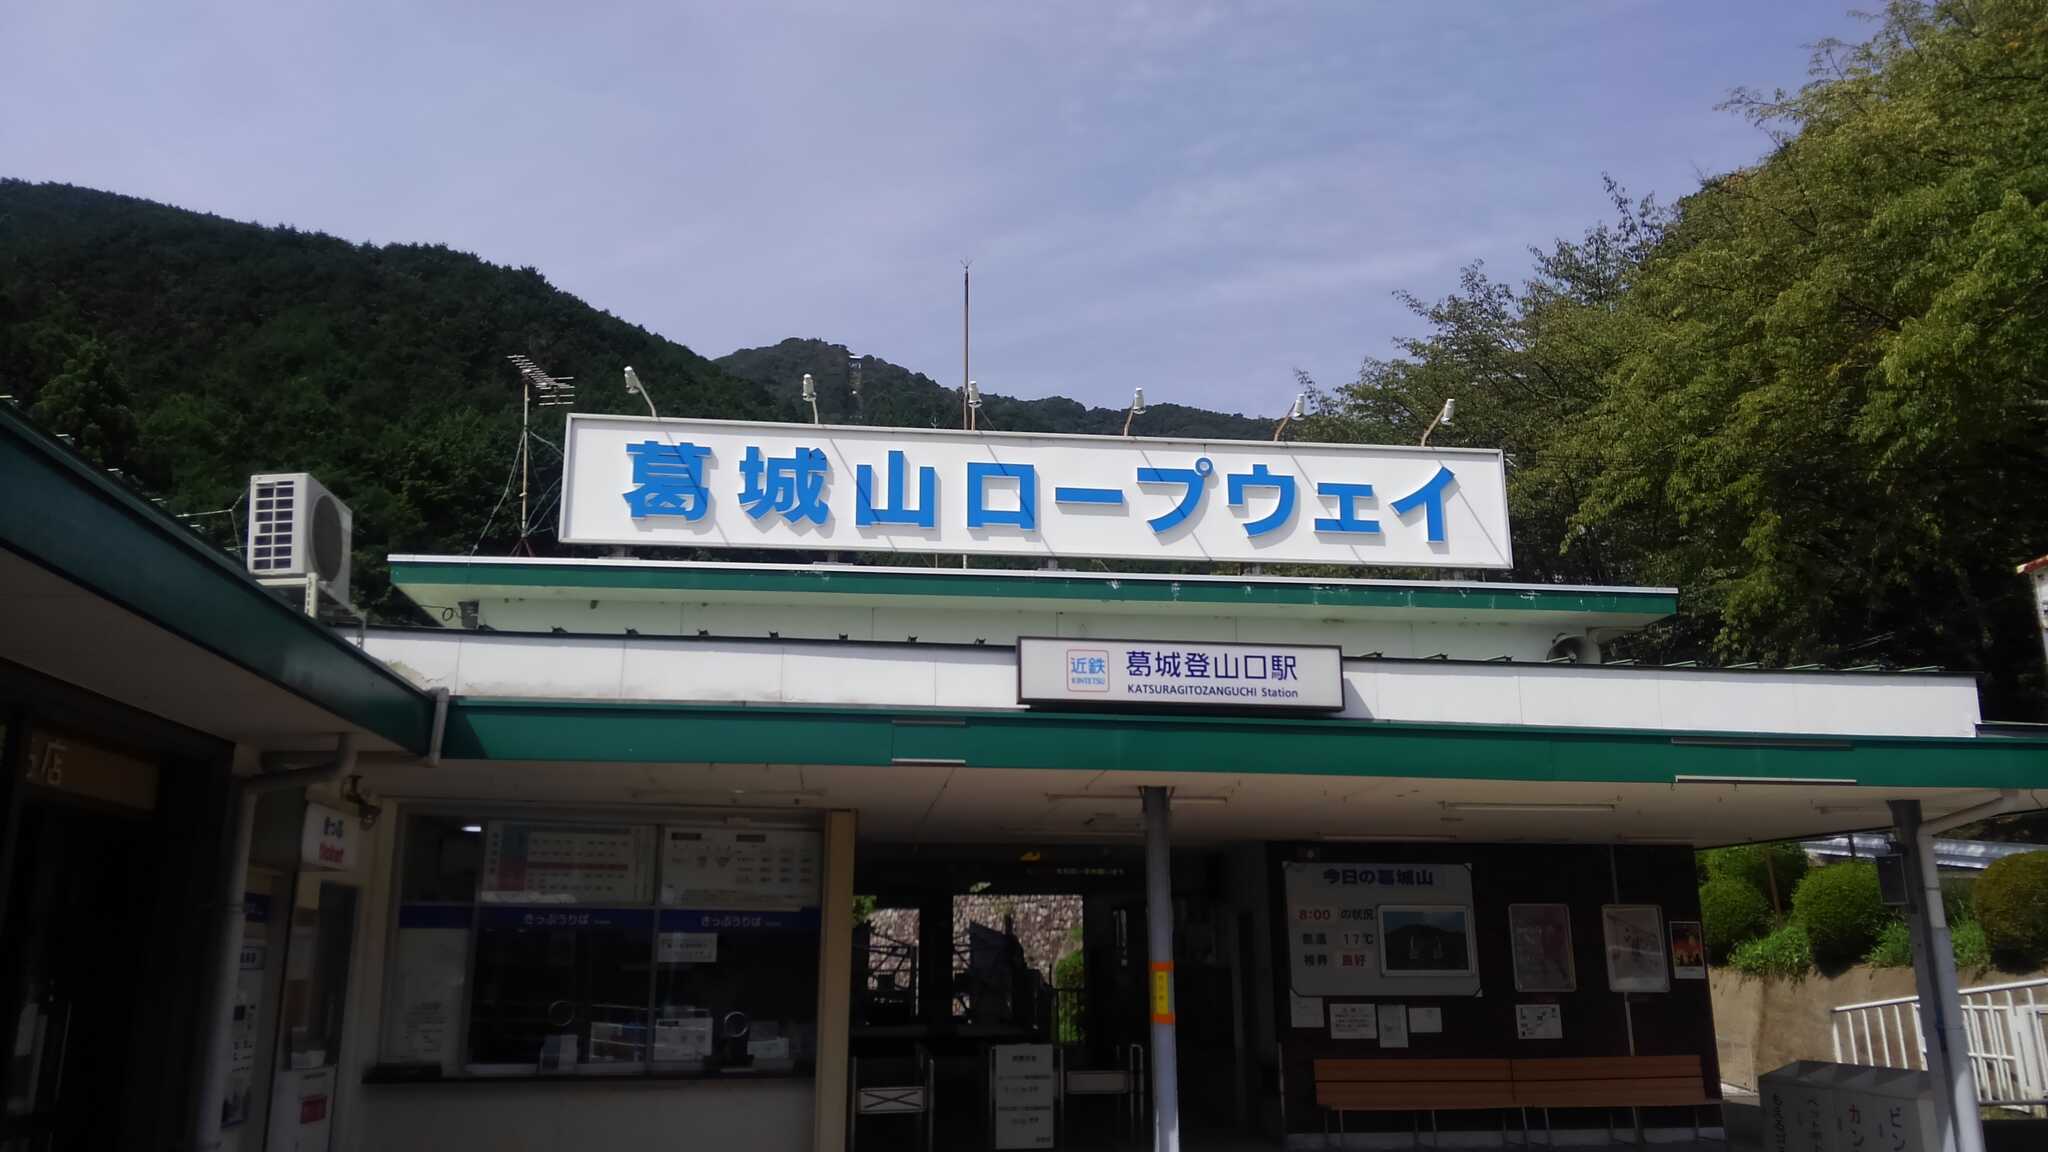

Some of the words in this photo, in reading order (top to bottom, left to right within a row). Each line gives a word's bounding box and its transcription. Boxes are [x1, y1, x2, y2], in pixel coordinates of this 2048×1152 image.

[623, 440, 1455, 542] 葛城山ロープウェイ
[1071, 656, 1105, 674] 近鉄
[1126, 650, 1298, 681] 葛城登山口駅
[1127, 683, 1257, 698] KATSURAGITOZANGUCHI
[1261, 687, 1298, 699] Station
[1323, 868, 1434, 887] 今日の葛城山
